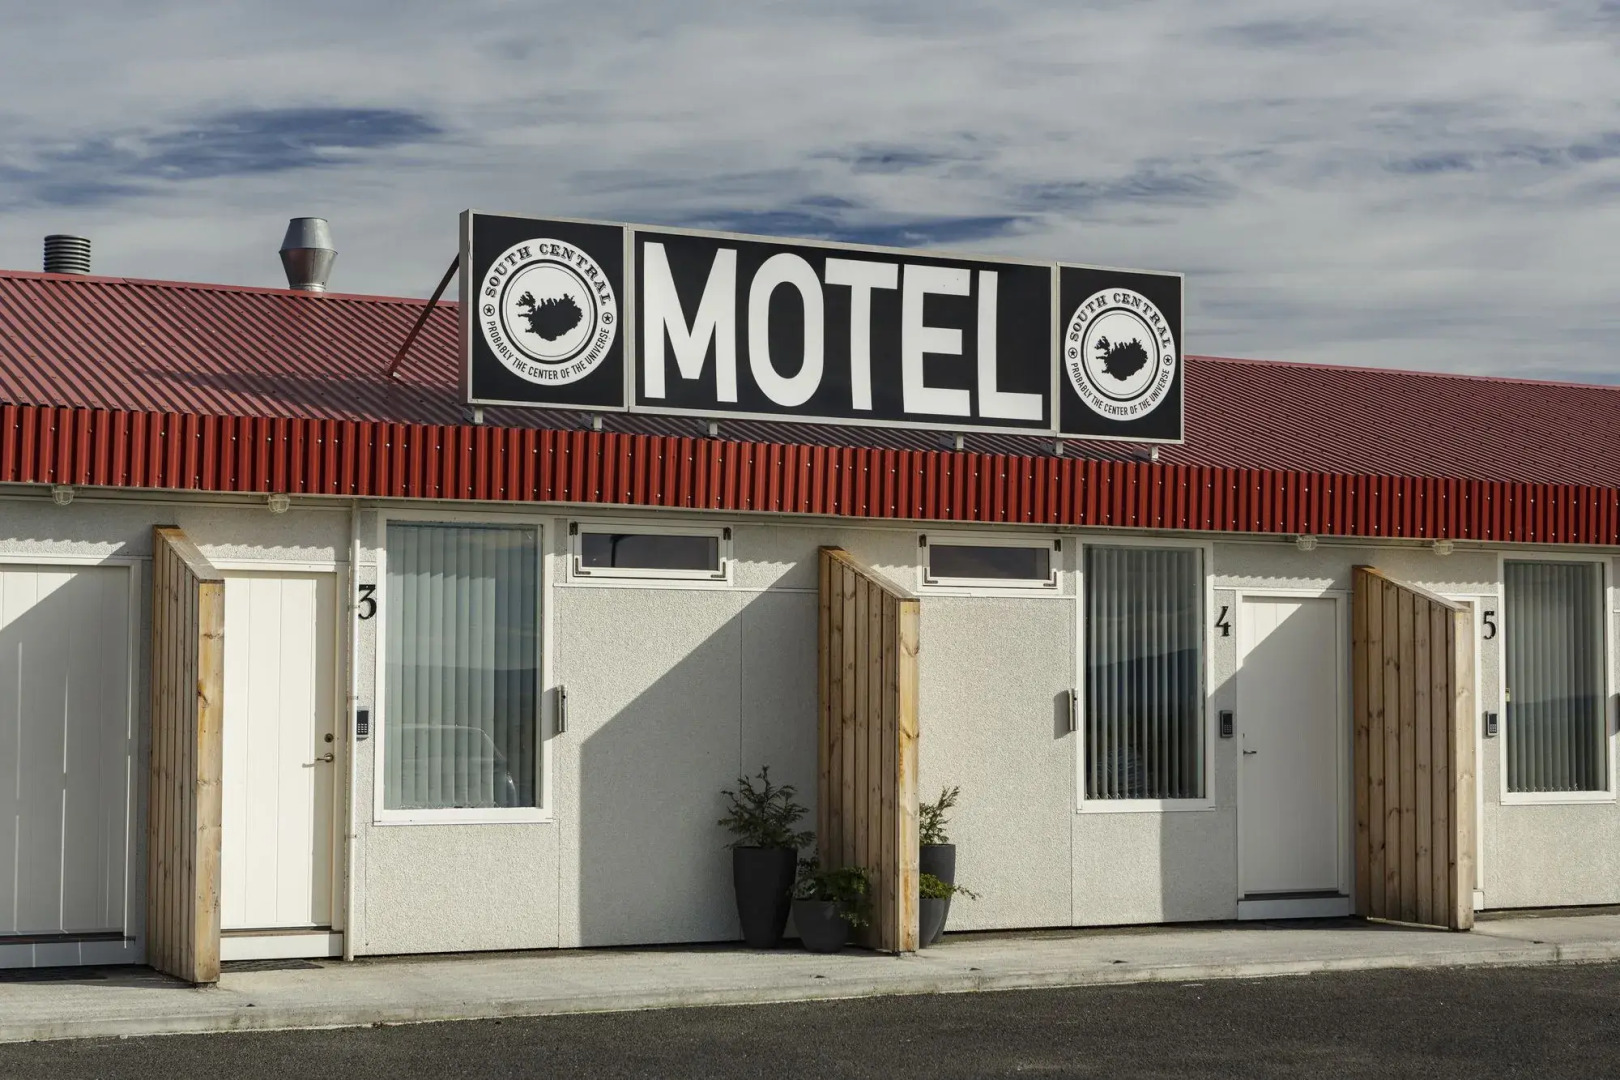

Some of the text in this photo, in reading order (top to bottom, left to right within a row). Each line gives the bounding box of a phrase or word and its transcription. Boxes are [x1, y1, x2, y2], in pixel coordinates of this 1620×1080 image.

[485, 243, 611, 306] SOUTH CENTRAL
[643, 241, 1043, 421] MOTEL
[1070, 293, 1171, 349] SOUTH CENTRAL
[487, 321, 609, 380] PROBABLY THE CENTER OF THE UNIVERSE
[1071, 363, 1169, 415] PROBABLY THE CENTER OF THE UNIVERSE
[358, 584, 377, 620] 3
[1215, 606, 1231, 637] 4
[1483, 611, 1497, 640] 5
